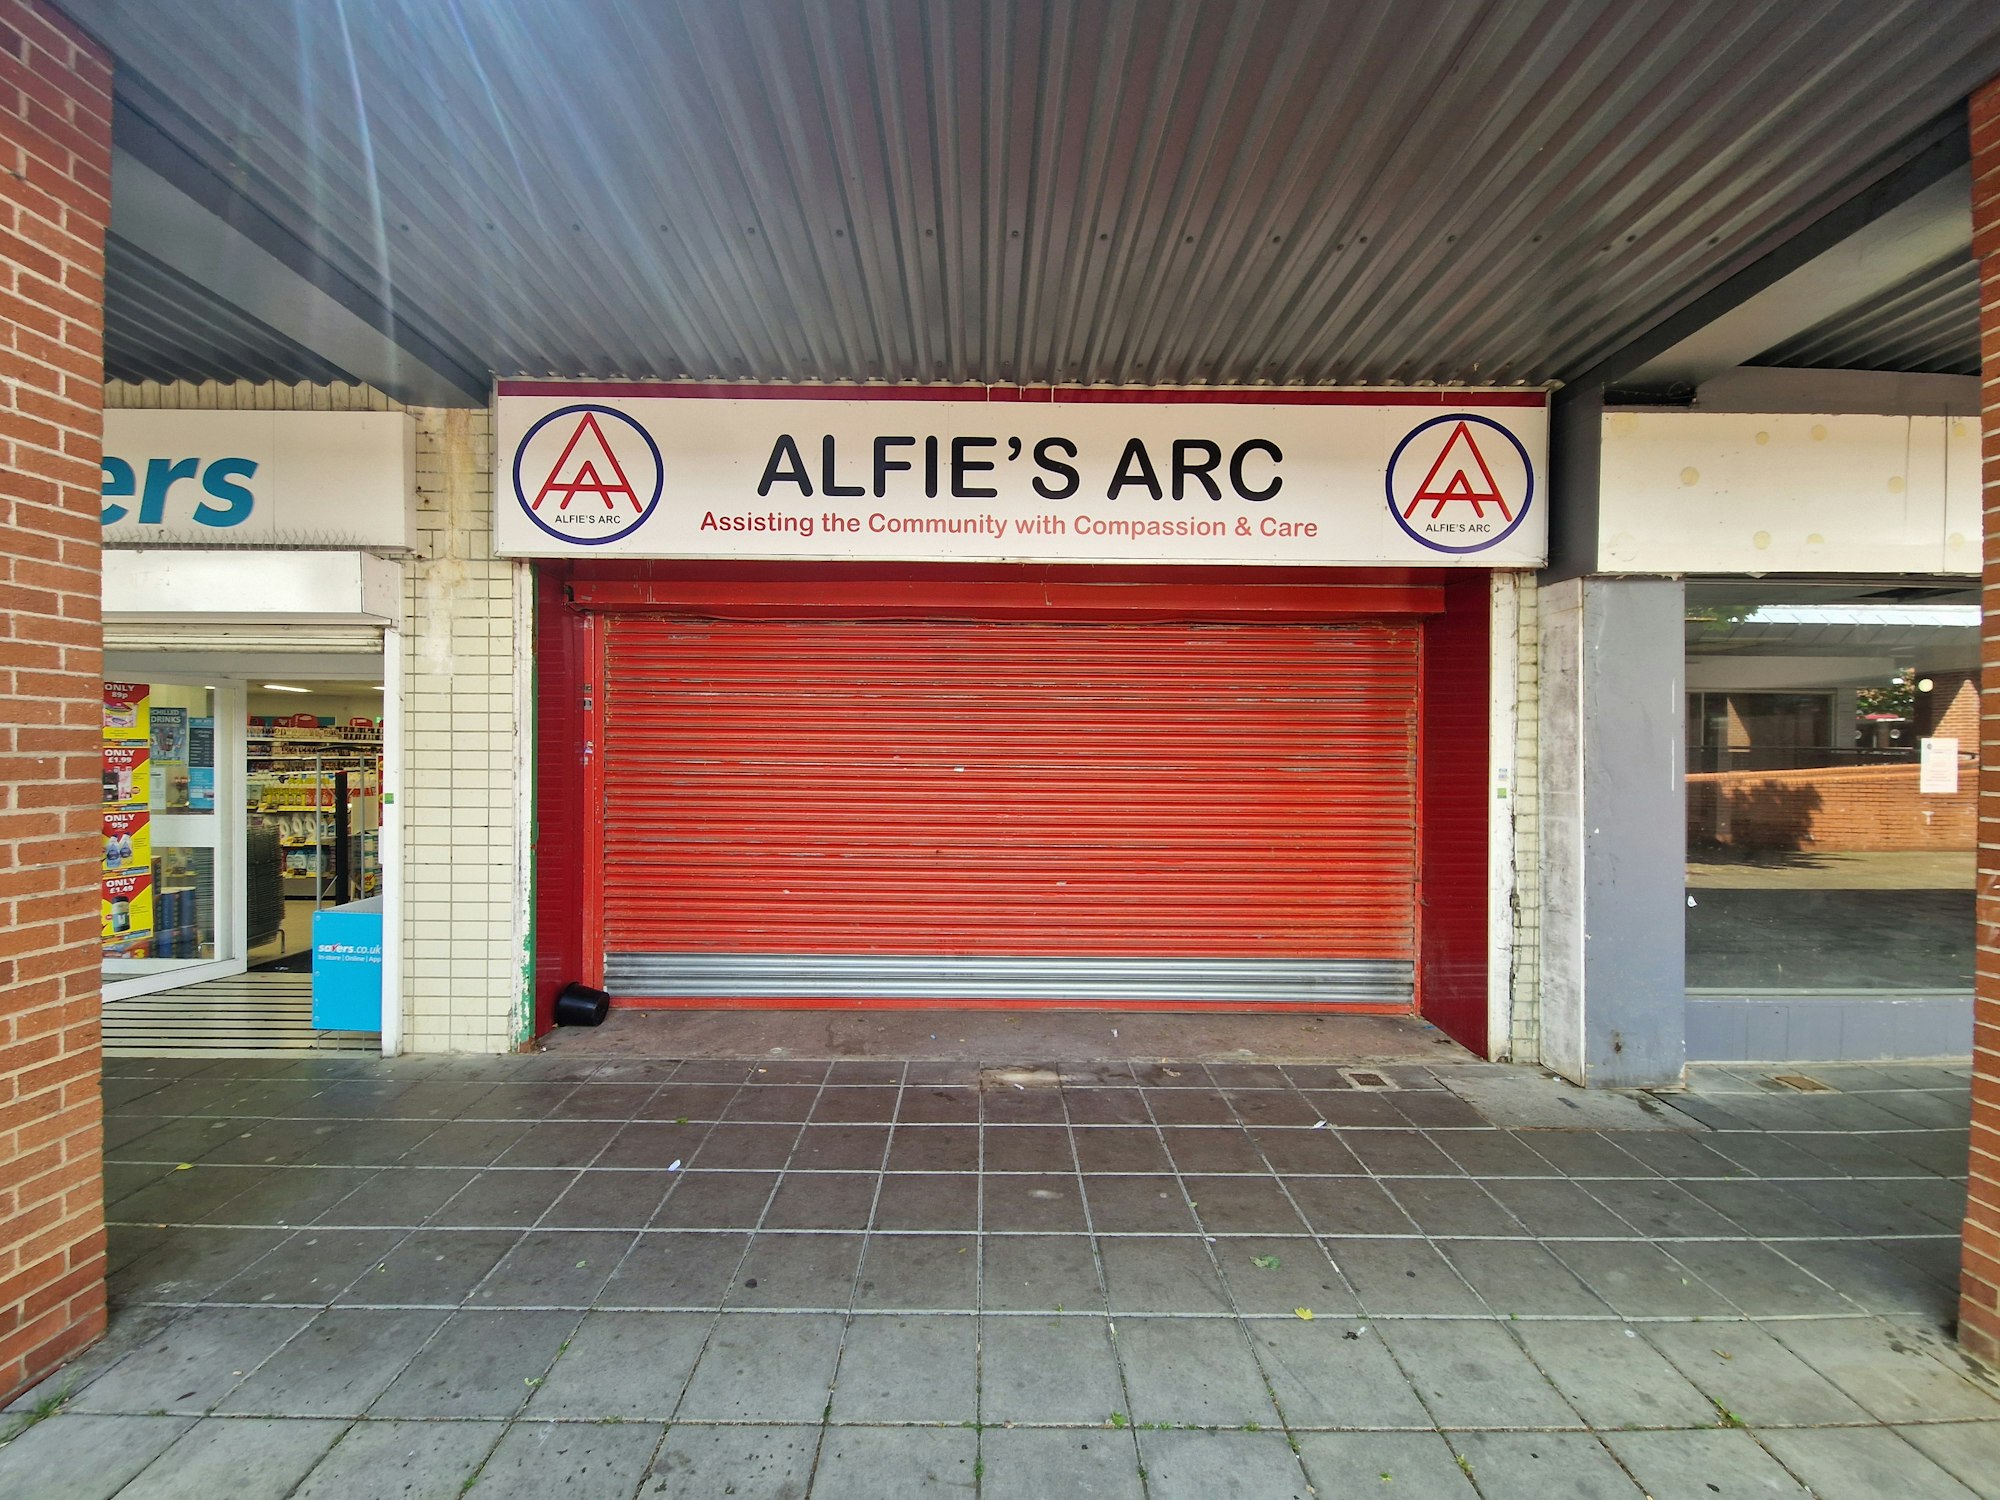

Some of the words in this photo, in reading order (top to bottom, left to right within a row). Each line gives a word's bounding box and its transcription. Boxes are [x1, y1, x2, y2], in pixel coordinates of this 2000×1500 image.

[757, 433, 1079, 500] ALFIE’S
[1106, 437, 1284, 502] ARC
[554, 515, 596, 524] ALFIE'S
[598, 515, 621, 524] ARC
[700, 511, 814, 538] Assisting
[822, 513, 861, 533] the
[868, 513, 1007, 539] Community
[1016, 514, 1065, 535] with
[1073, 516, 1227, 539] Compassion
[1234, 516, 1252, 537] &
[1259, 517, 1318, 538] Care
[1425, 523, 1466, 533] ALFIE'S
[1468, 523, 1491, 533] ARC
[104, 683, 135, 691] ONLY
[111, 691, 128, 699] 89p
[151, 715, 181, 723] DRINKS
[104, 749, 135, 757] ONLY
[104, 814, 135, 822] ONLY
[106, 877, 136, 888] ONLY
[109, 885, 134, 894] £1.49
